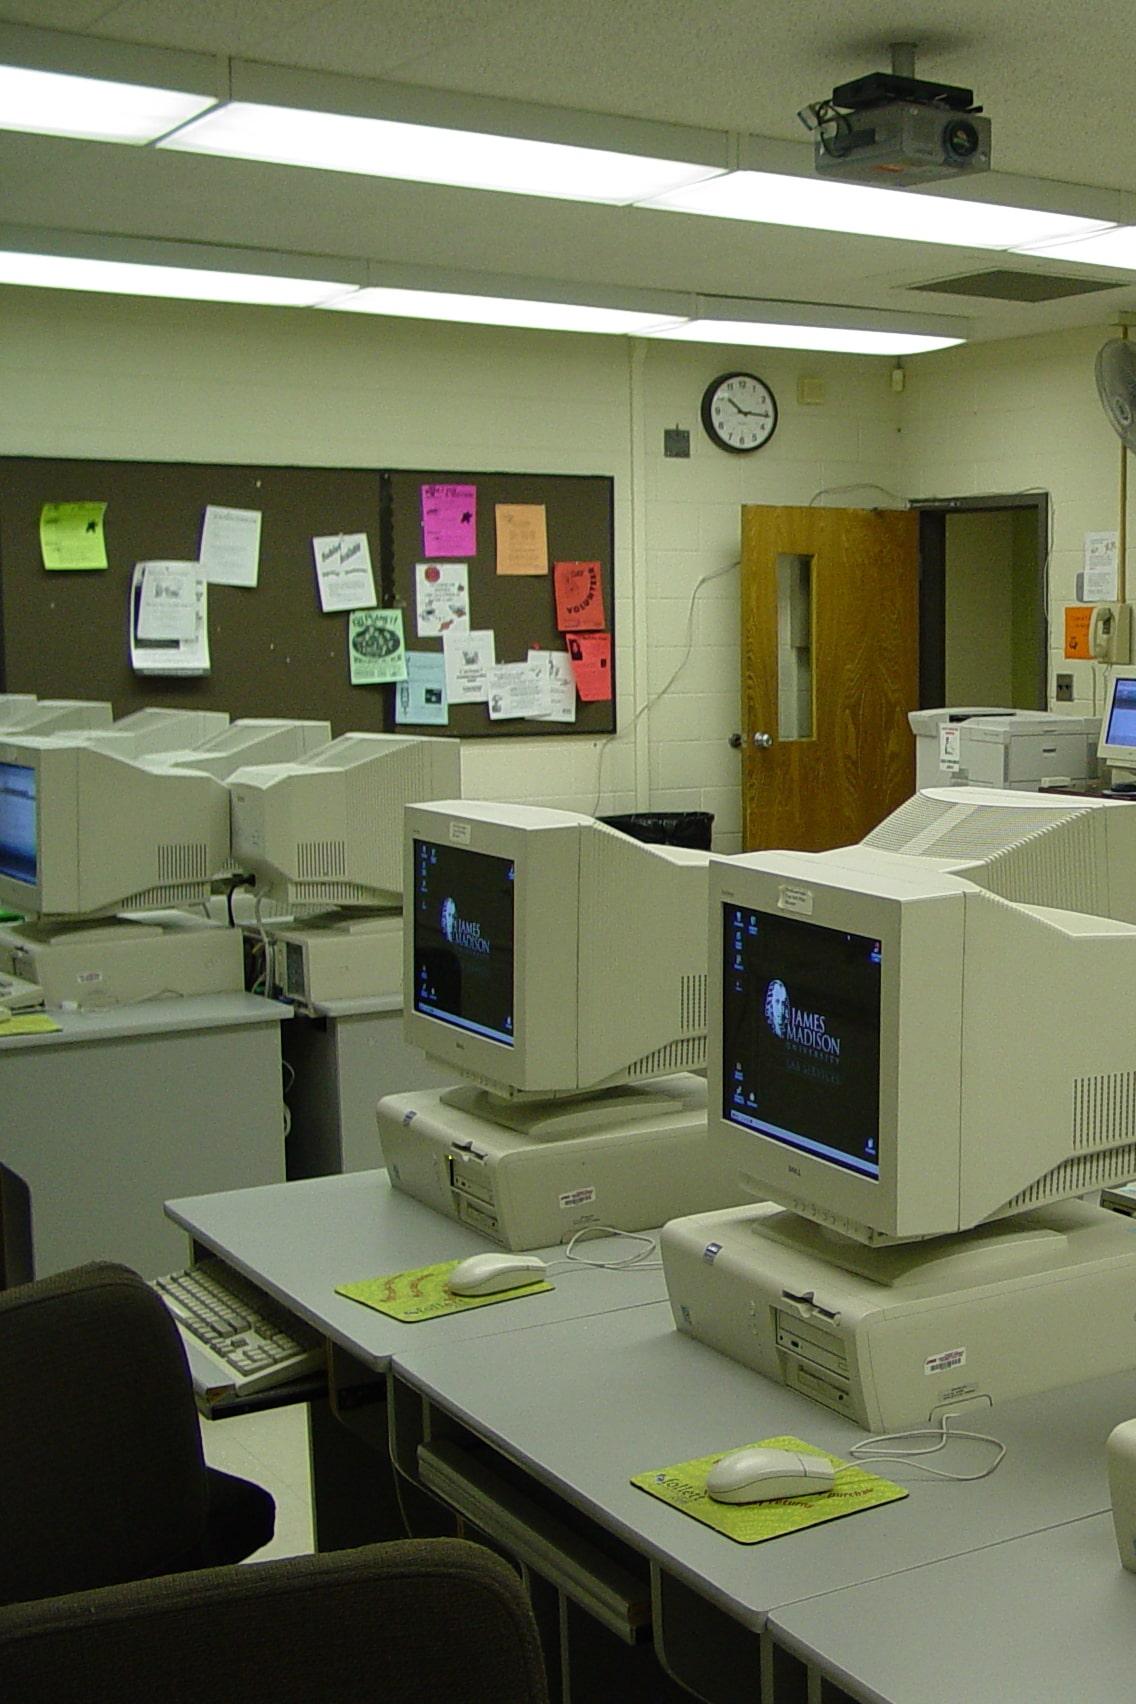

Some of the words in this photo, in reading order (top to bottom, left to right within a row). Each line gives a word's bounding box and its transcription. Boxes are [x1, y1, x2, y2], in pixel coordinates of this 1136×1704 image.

[566, 566, 598, 614] VOLUNTEER
[791, 1008, 825, 1033] JAMES
[786, 1024, 840, 1055] MADISON
